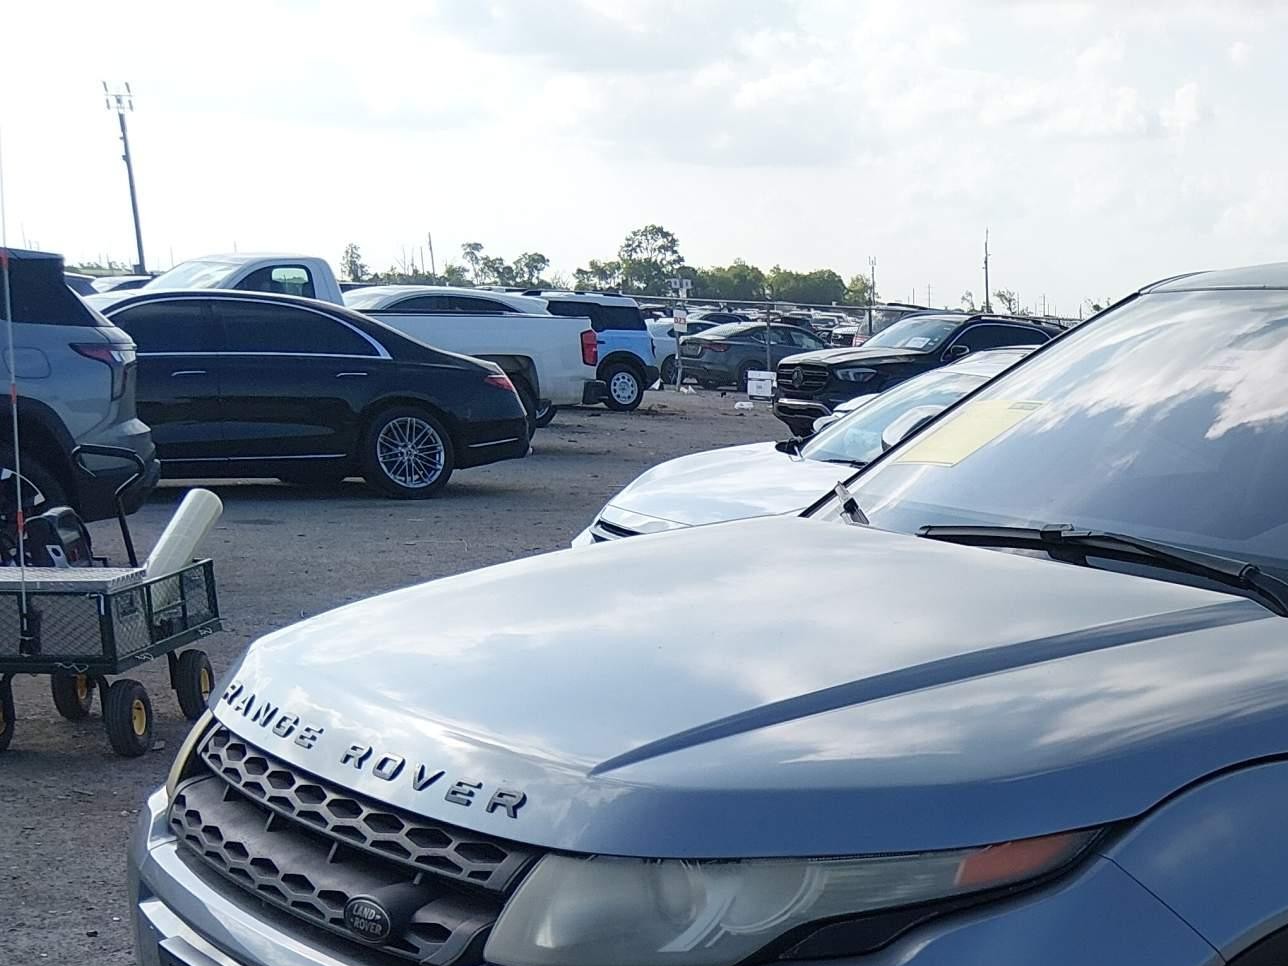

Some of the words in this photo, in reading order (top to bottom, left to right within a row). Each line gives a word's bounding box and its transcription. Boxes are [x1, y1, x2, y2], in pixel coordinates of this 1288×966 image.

[222, 680, 324, 749] RANGE
[340, 745, 527, 819] ROVER
[353, 903, 376, 920] LAND
[353, 917, 382, 936] ROVER
